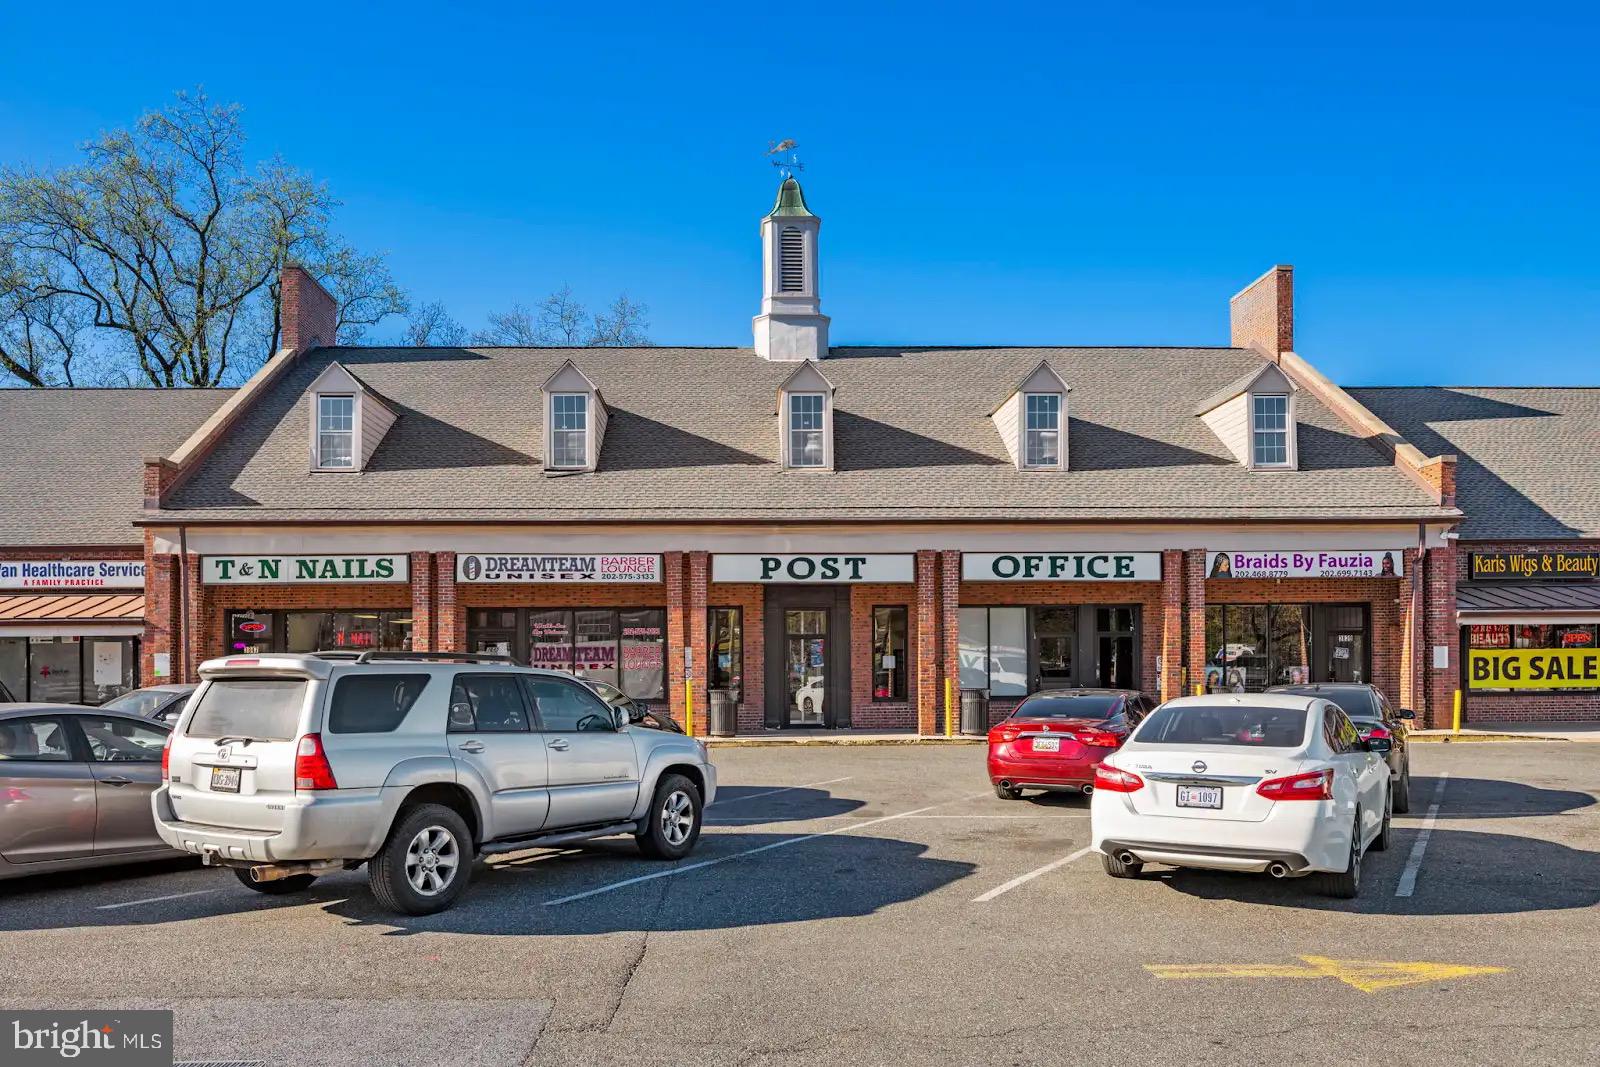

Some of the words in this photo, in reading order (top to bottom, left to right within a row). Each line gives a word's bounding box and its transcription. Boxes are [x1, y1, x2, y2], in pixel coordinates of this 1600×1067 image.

[295, 558, 395, 579] NAILS
[485, 557, 596, 572] DREAMTEAM
[601, 557, 655, 565] BARBER
[601, 565, 655, 573] LOUNGE
[760, 557, 866, 580] POST
[992, 555, 1135, 579] OFFICE
[1234, 554, 1288, 569] Braids
[1293, 554, 1314, 571] By
[1319, 553, 1373, 568] Fauzia
[1474, 554, 1506, 573] Karis
[1509, 554, 1538, 577] Wigs
[1541, 554, 1553, 572] &
[1556, 554, 1599, 576] Beauty
[0, 563, 17, 578] an
[22, 562, 95, 578] Healthcare
[1320, 570, 1373, 578] 202.699.7143
[1473, 656, 1520, 680] BIG
[1529, 656, 1598, 680] SALE
